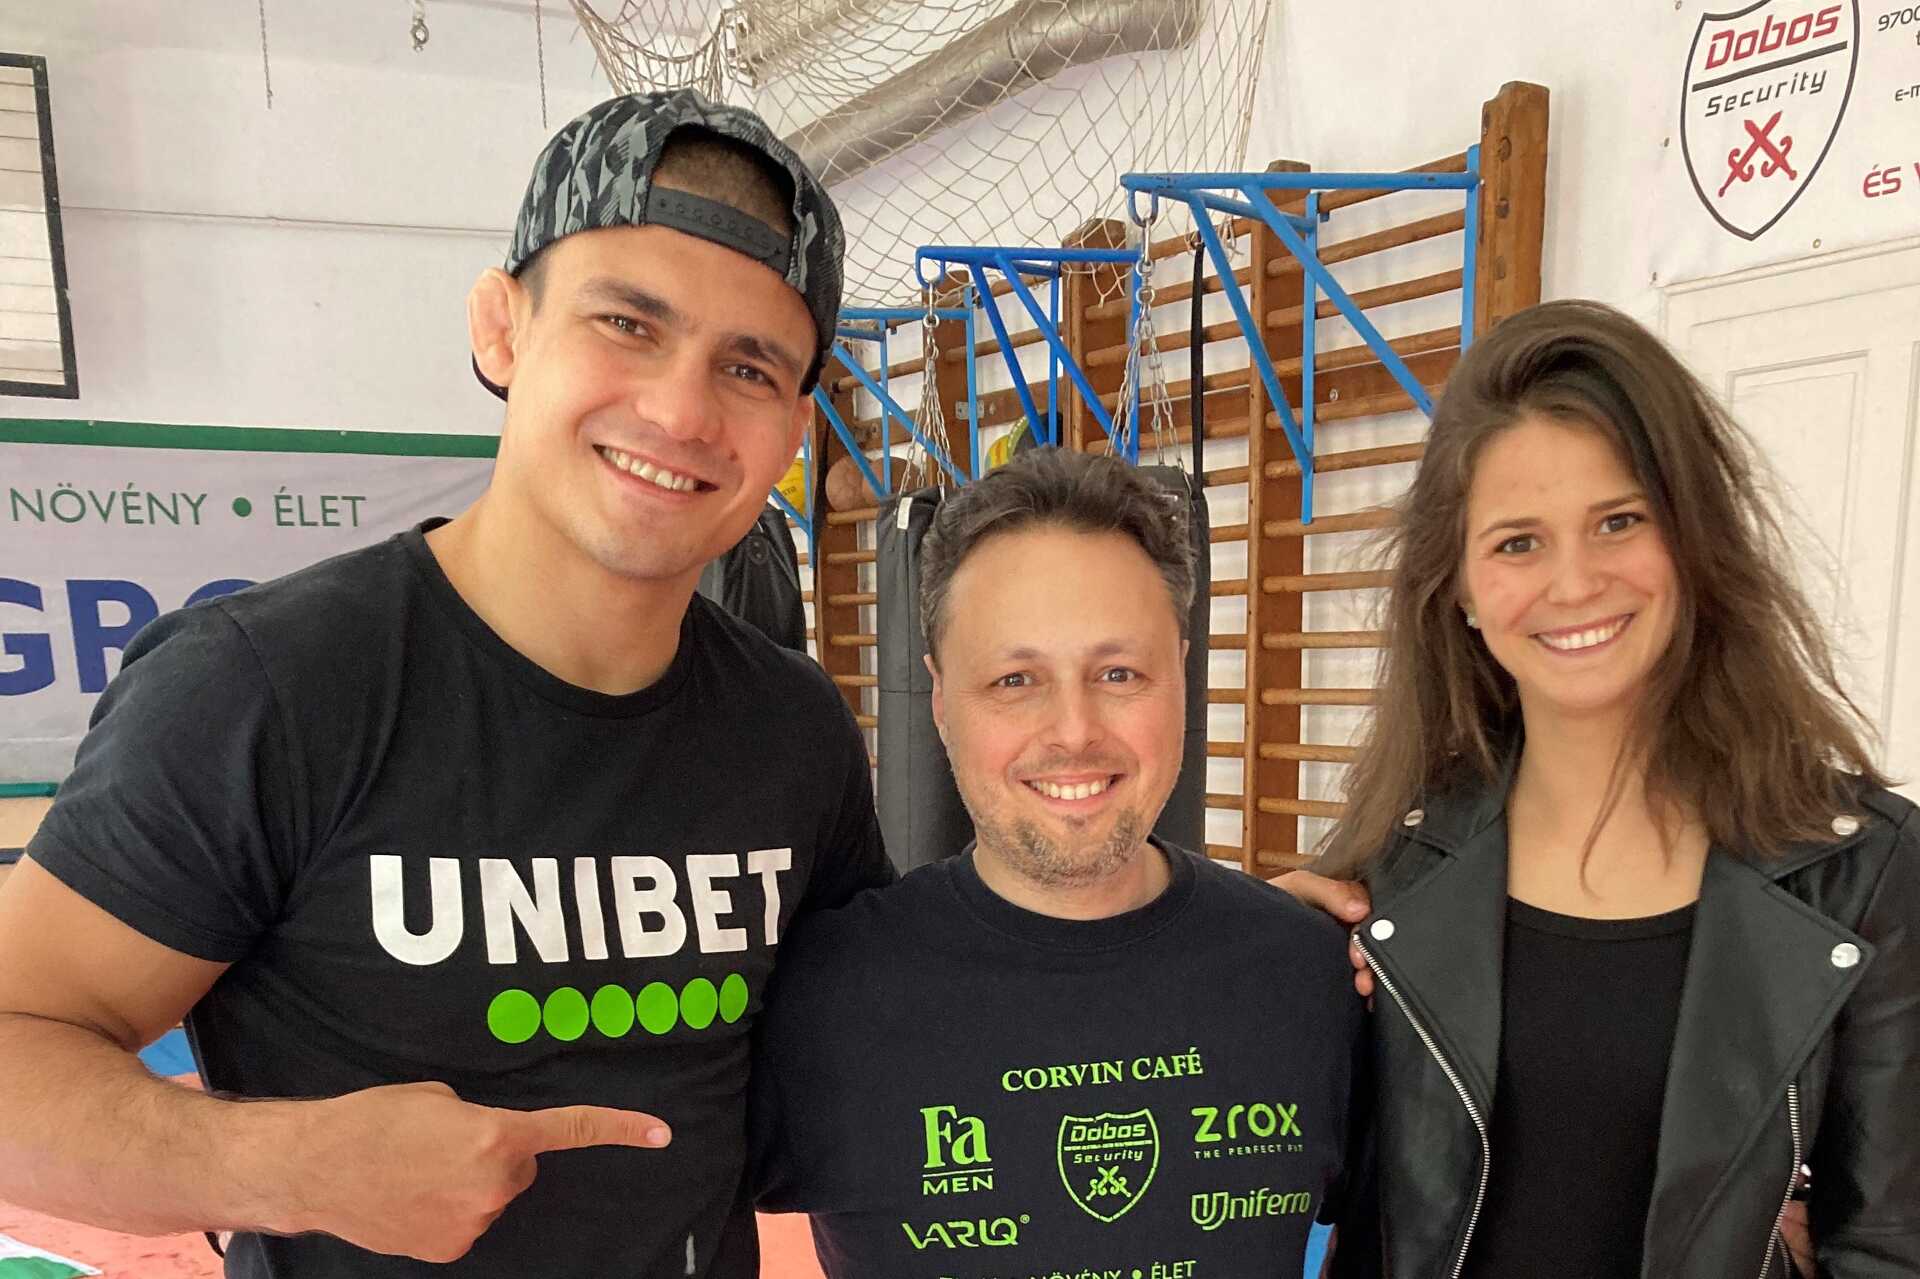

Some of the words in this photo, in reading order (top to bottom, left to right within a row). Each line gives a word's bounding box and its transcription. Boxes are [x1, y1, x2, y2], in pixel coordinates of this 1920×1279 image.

[1704, 4, 1842, 70] Dobos
[1704, 70, 1827, 118] Security
[9, 482, 208, 527] NÖVÉNY
[274, 486, 367, 528] ÉLET
[369, 847, 793, 966] UNIBET
[1002, 1060, 1124, 1092] CORVIN
[1131, 1046, 1204, 1081] CAFÉ
[919, 1105, 993, 1169] Fa
[1070, 1122, 1147, 1142] Dobos
[1194, 1149, 1221, 1160] THE
[1228, 1144, 1282, 1156] PERFECT
[1073, 1149, 1143, 1164] Security
[923, 1174, 994, 1196] MEN
[1191, 1187, 1311, 1231] Uniferro
[1151, 1260, 1197, 1279] ÉLET
